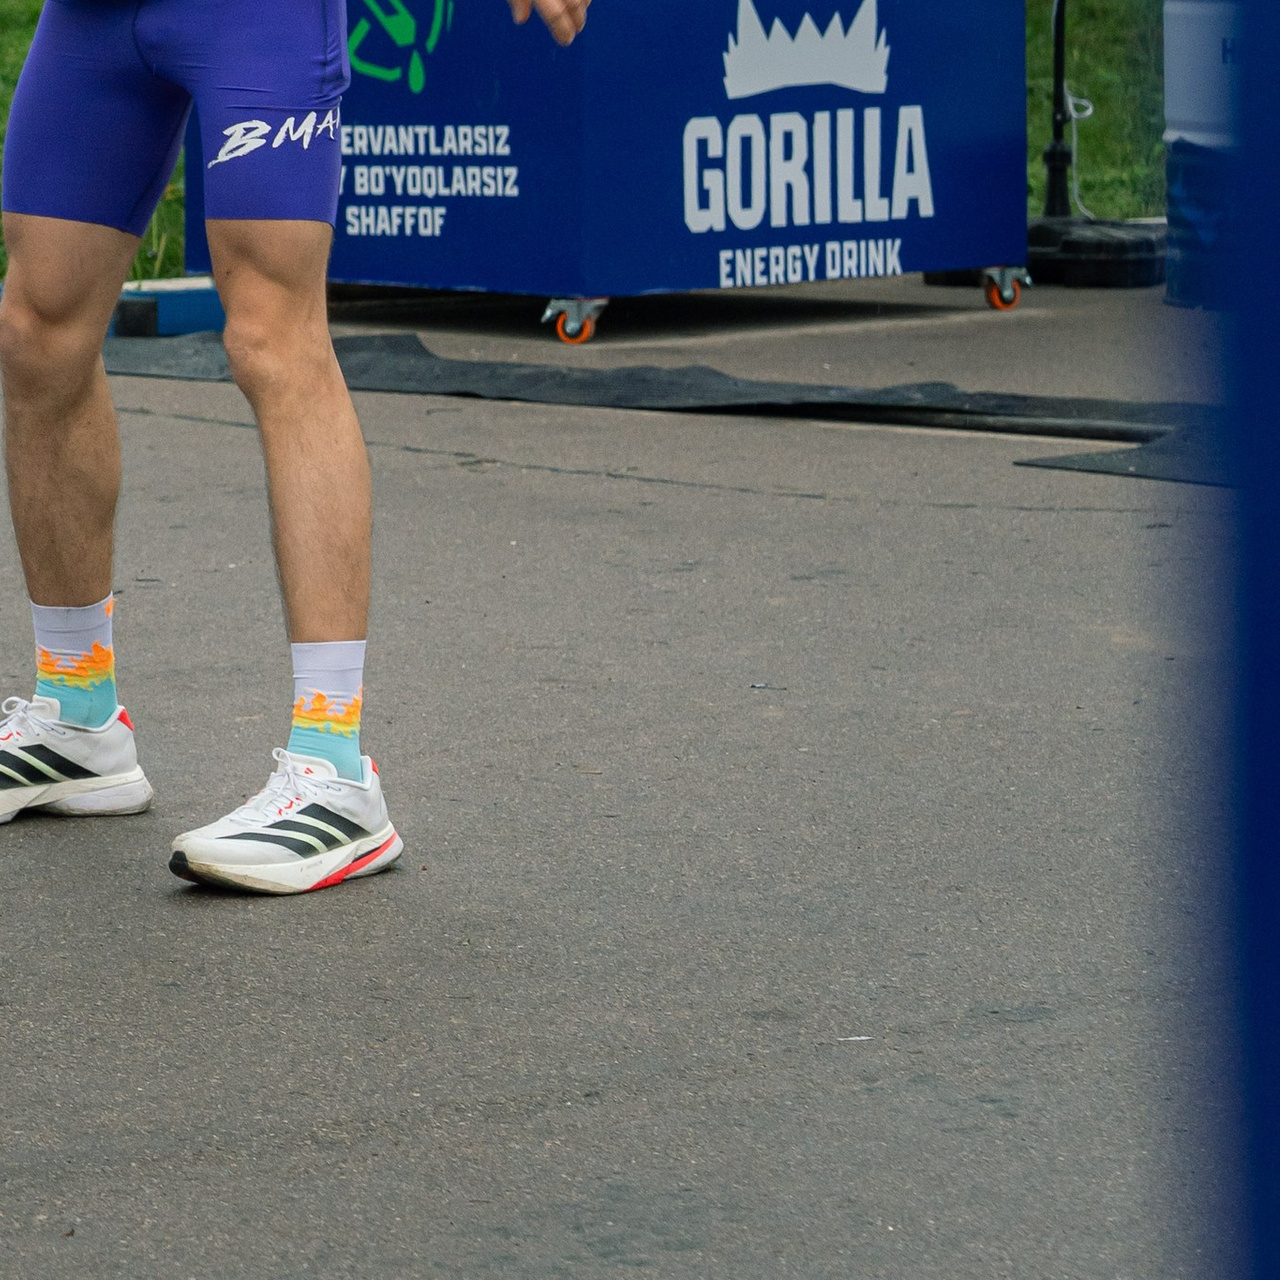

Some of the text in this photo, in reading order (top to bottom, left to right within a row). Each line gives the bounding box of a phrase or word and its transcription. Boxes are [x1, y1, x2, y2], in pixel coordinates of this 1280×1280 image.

[354, 165, 519, 197] BO'YOQLARSIZ
[683, 105, 935, 234] GORILLA
[345, 205, 447, 237] SHAFFOF
[720, 238, 902, 289] ENERGY DRINK
